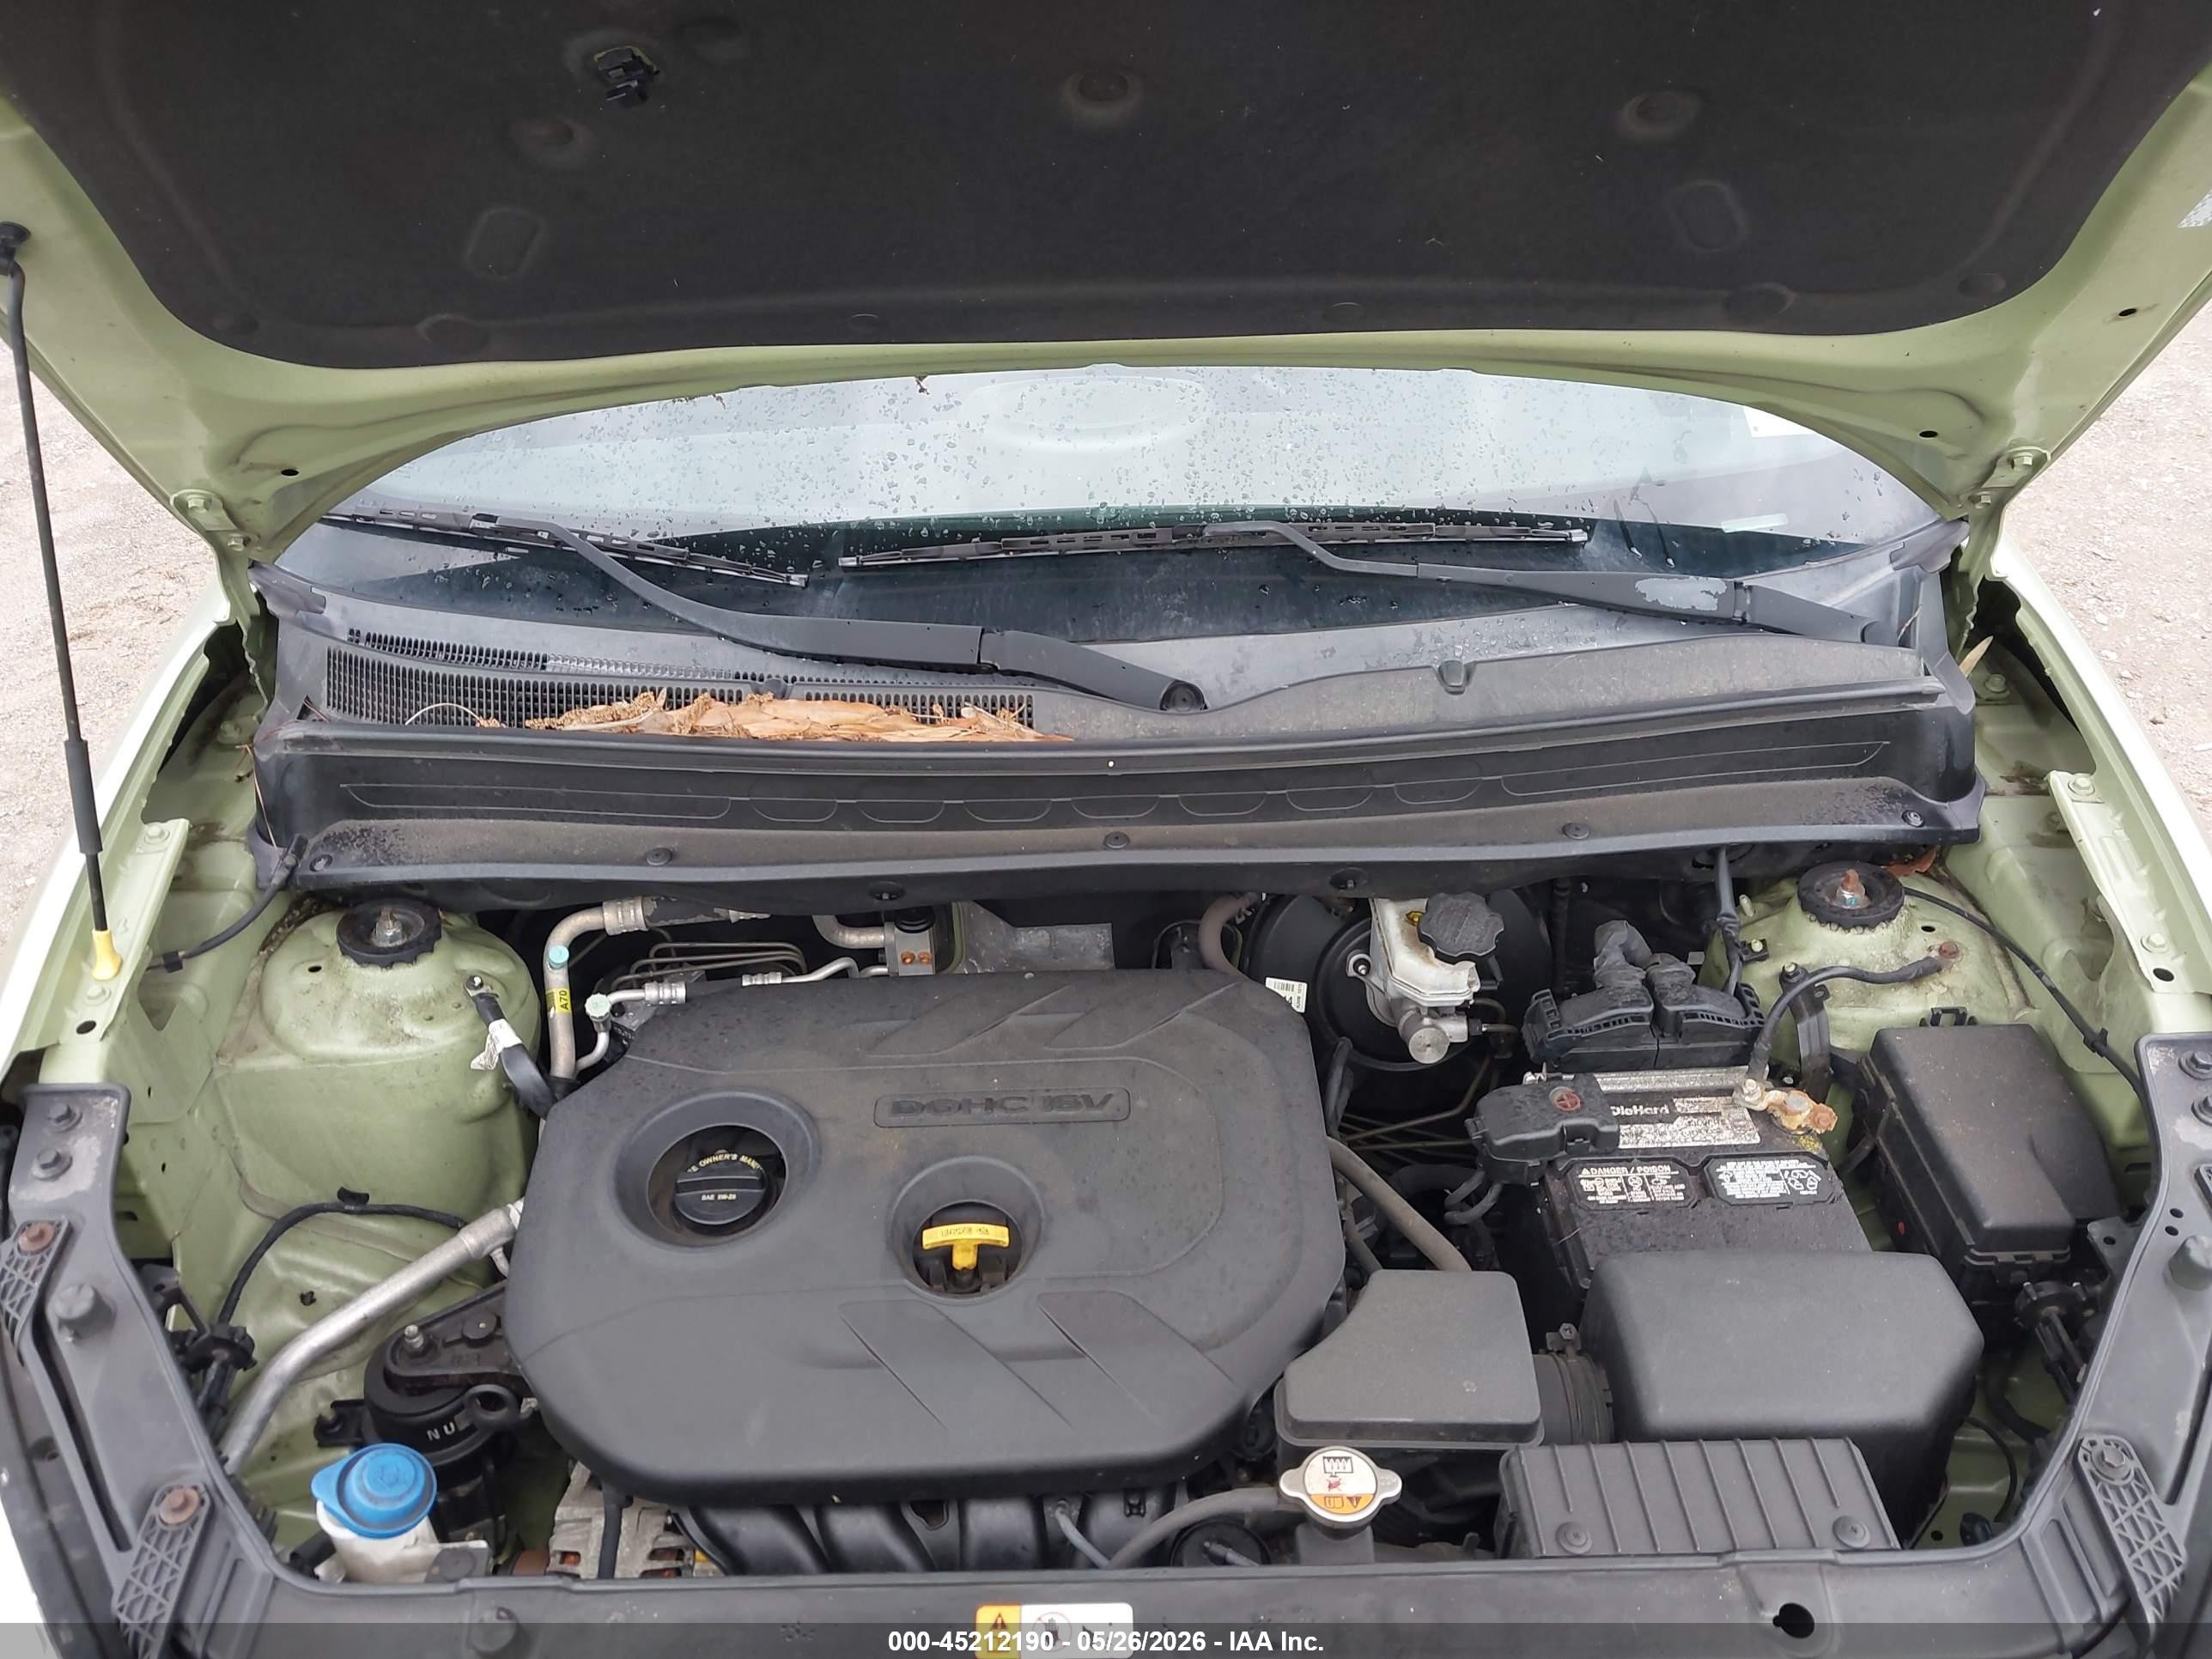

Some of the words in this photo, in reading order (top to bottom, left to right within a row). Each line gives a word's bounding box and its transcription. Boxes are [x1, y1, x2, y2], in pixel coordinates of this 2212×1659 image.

[559, 990, 568, 1011] A70
[890, 1097, 1029, 1115] DOHC
[699, 1153, 738, 1167] OWNER'S
[1590, 1166, 1629, 1176] DANGER
[1636, 1164, 1671, 1175] POISON
